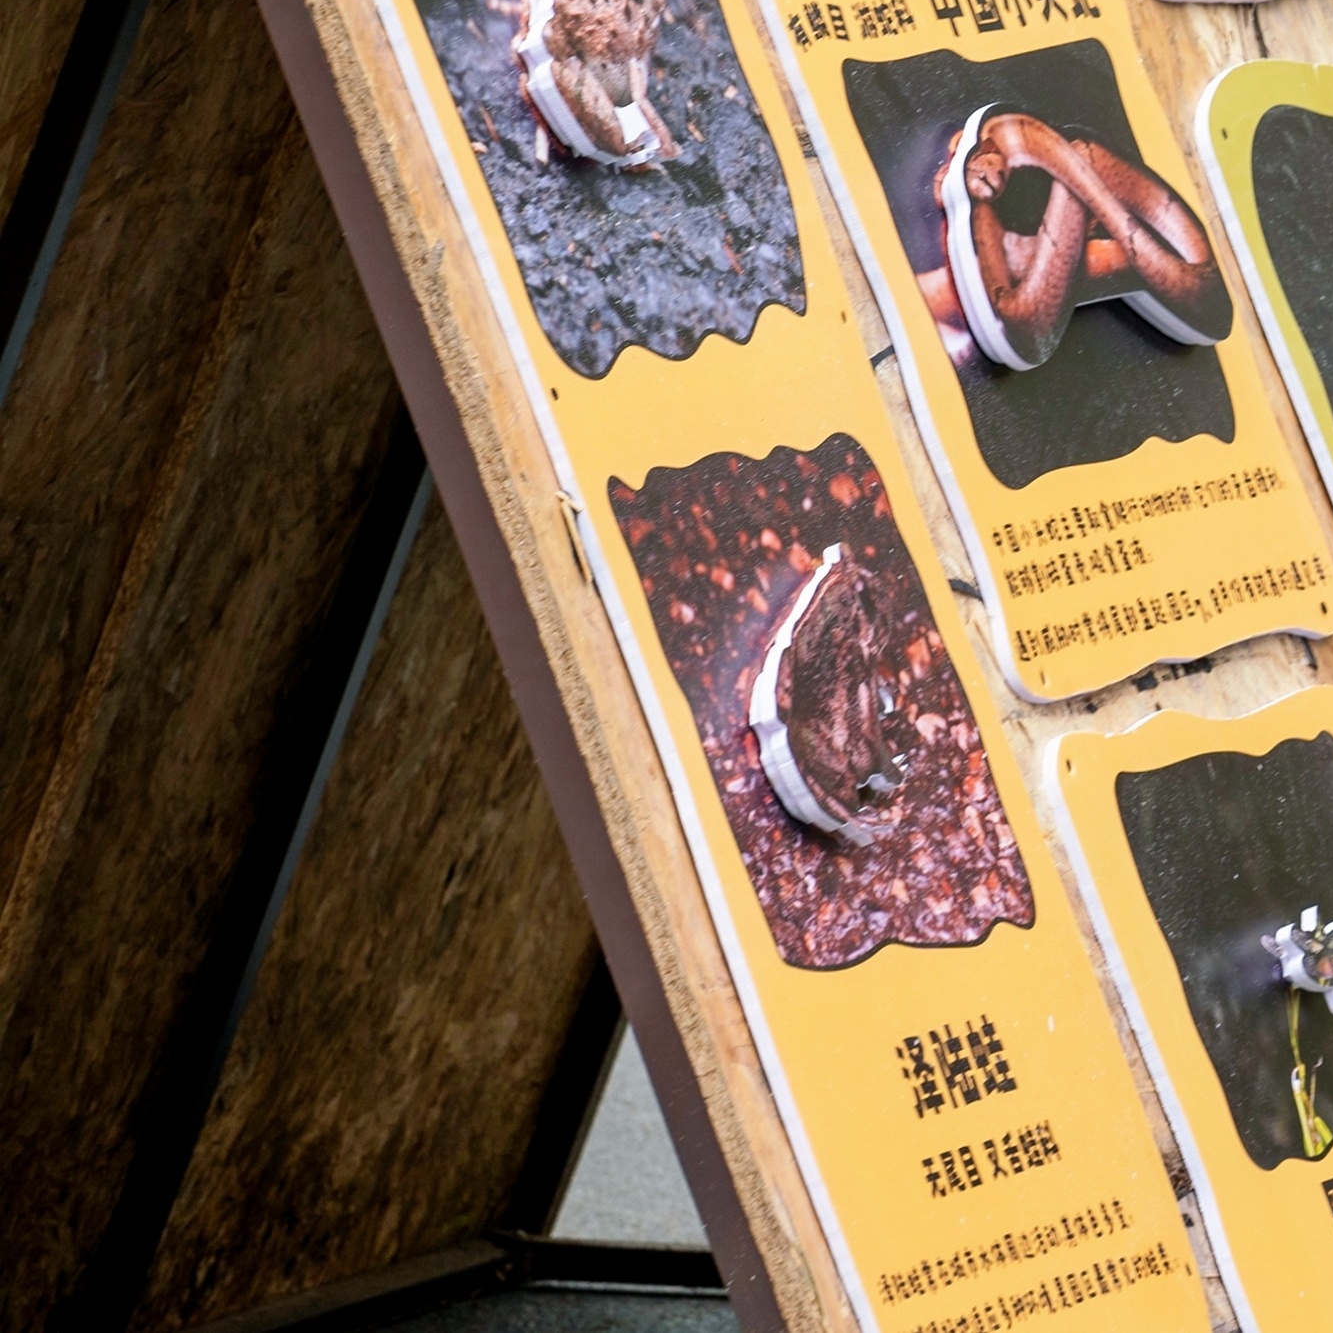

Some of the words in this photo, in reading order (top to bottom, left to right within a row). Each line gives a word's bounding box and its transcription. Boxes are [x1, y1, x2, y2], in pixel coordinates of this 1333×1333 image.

[787, 0, 851, 53] 有鳞目
[895, 1014, 1018, 1119] 泽陆蛙
[921, 1145, 984, 1199] 无尾目
[983, 1119, 1063, 1179] 叉舌蛙科
